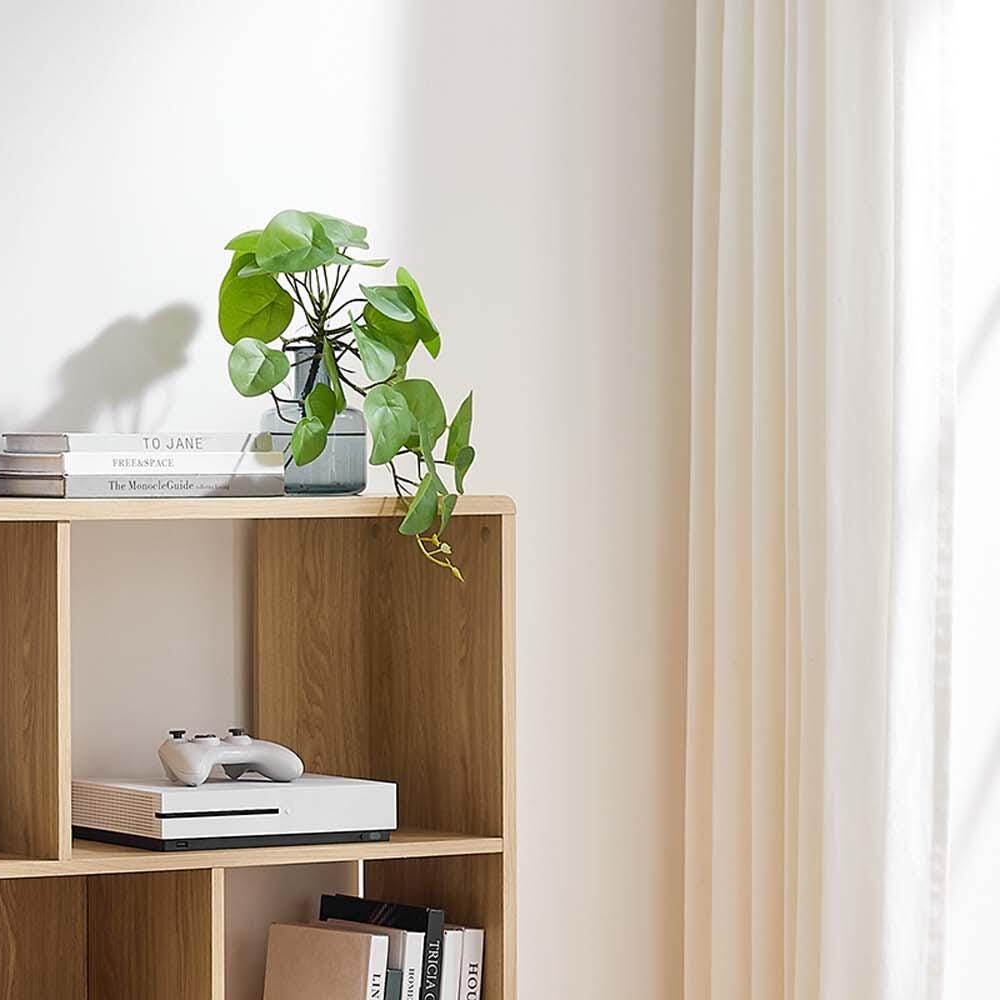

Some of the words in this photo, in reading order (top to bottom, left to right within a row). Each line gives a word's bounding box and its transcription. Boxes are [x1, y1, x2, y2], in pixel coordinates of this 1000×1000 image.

[143, 437, 161, 450] TO
[166, 437, 203, 450] JANE
[108, 480, 126, 491] The
[426, 940, 440, 990] TRICIA
[407, 968, 415, 1000] HOME
